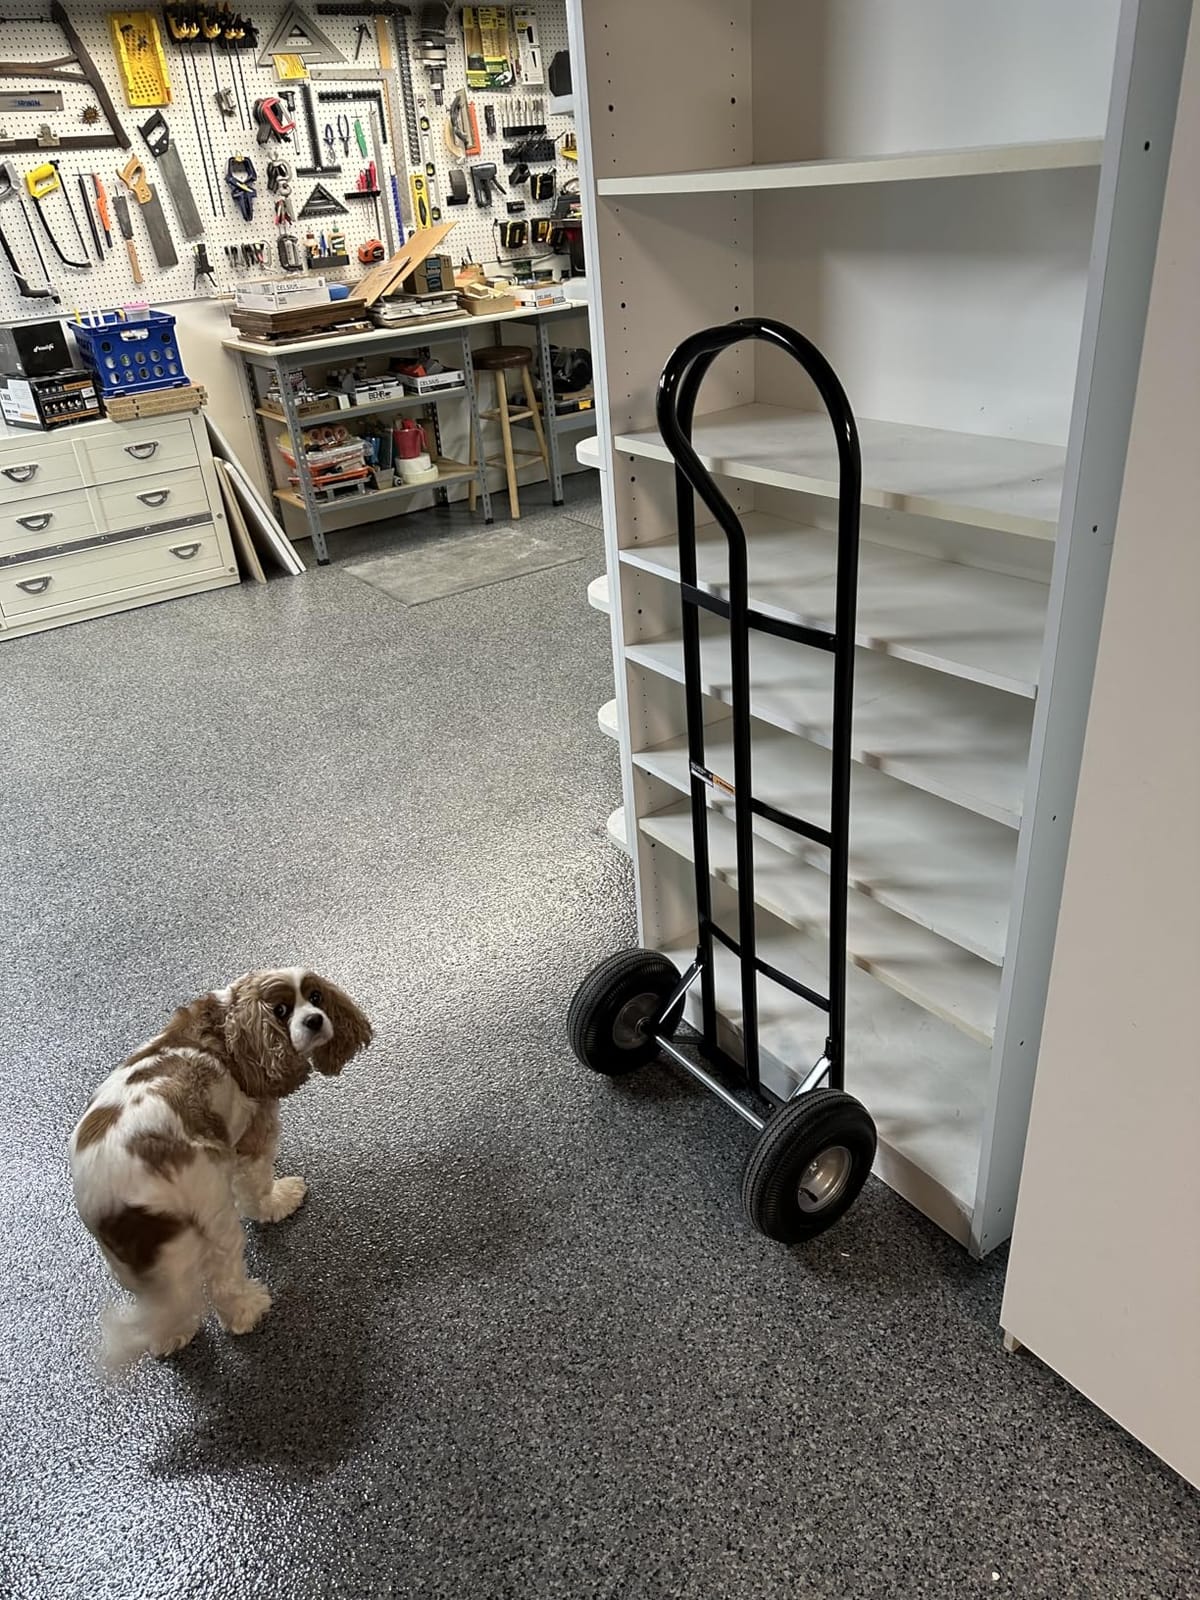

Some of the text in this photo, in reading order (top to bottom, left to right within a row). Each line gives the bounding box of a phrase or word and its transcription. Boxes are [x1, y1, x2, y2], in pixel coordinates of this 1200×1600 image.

[276, 283, 299, 291] CELSIUS
[419, 378, 440, 387] CELSIUS
[368, 390, 385, 400] BEHR
